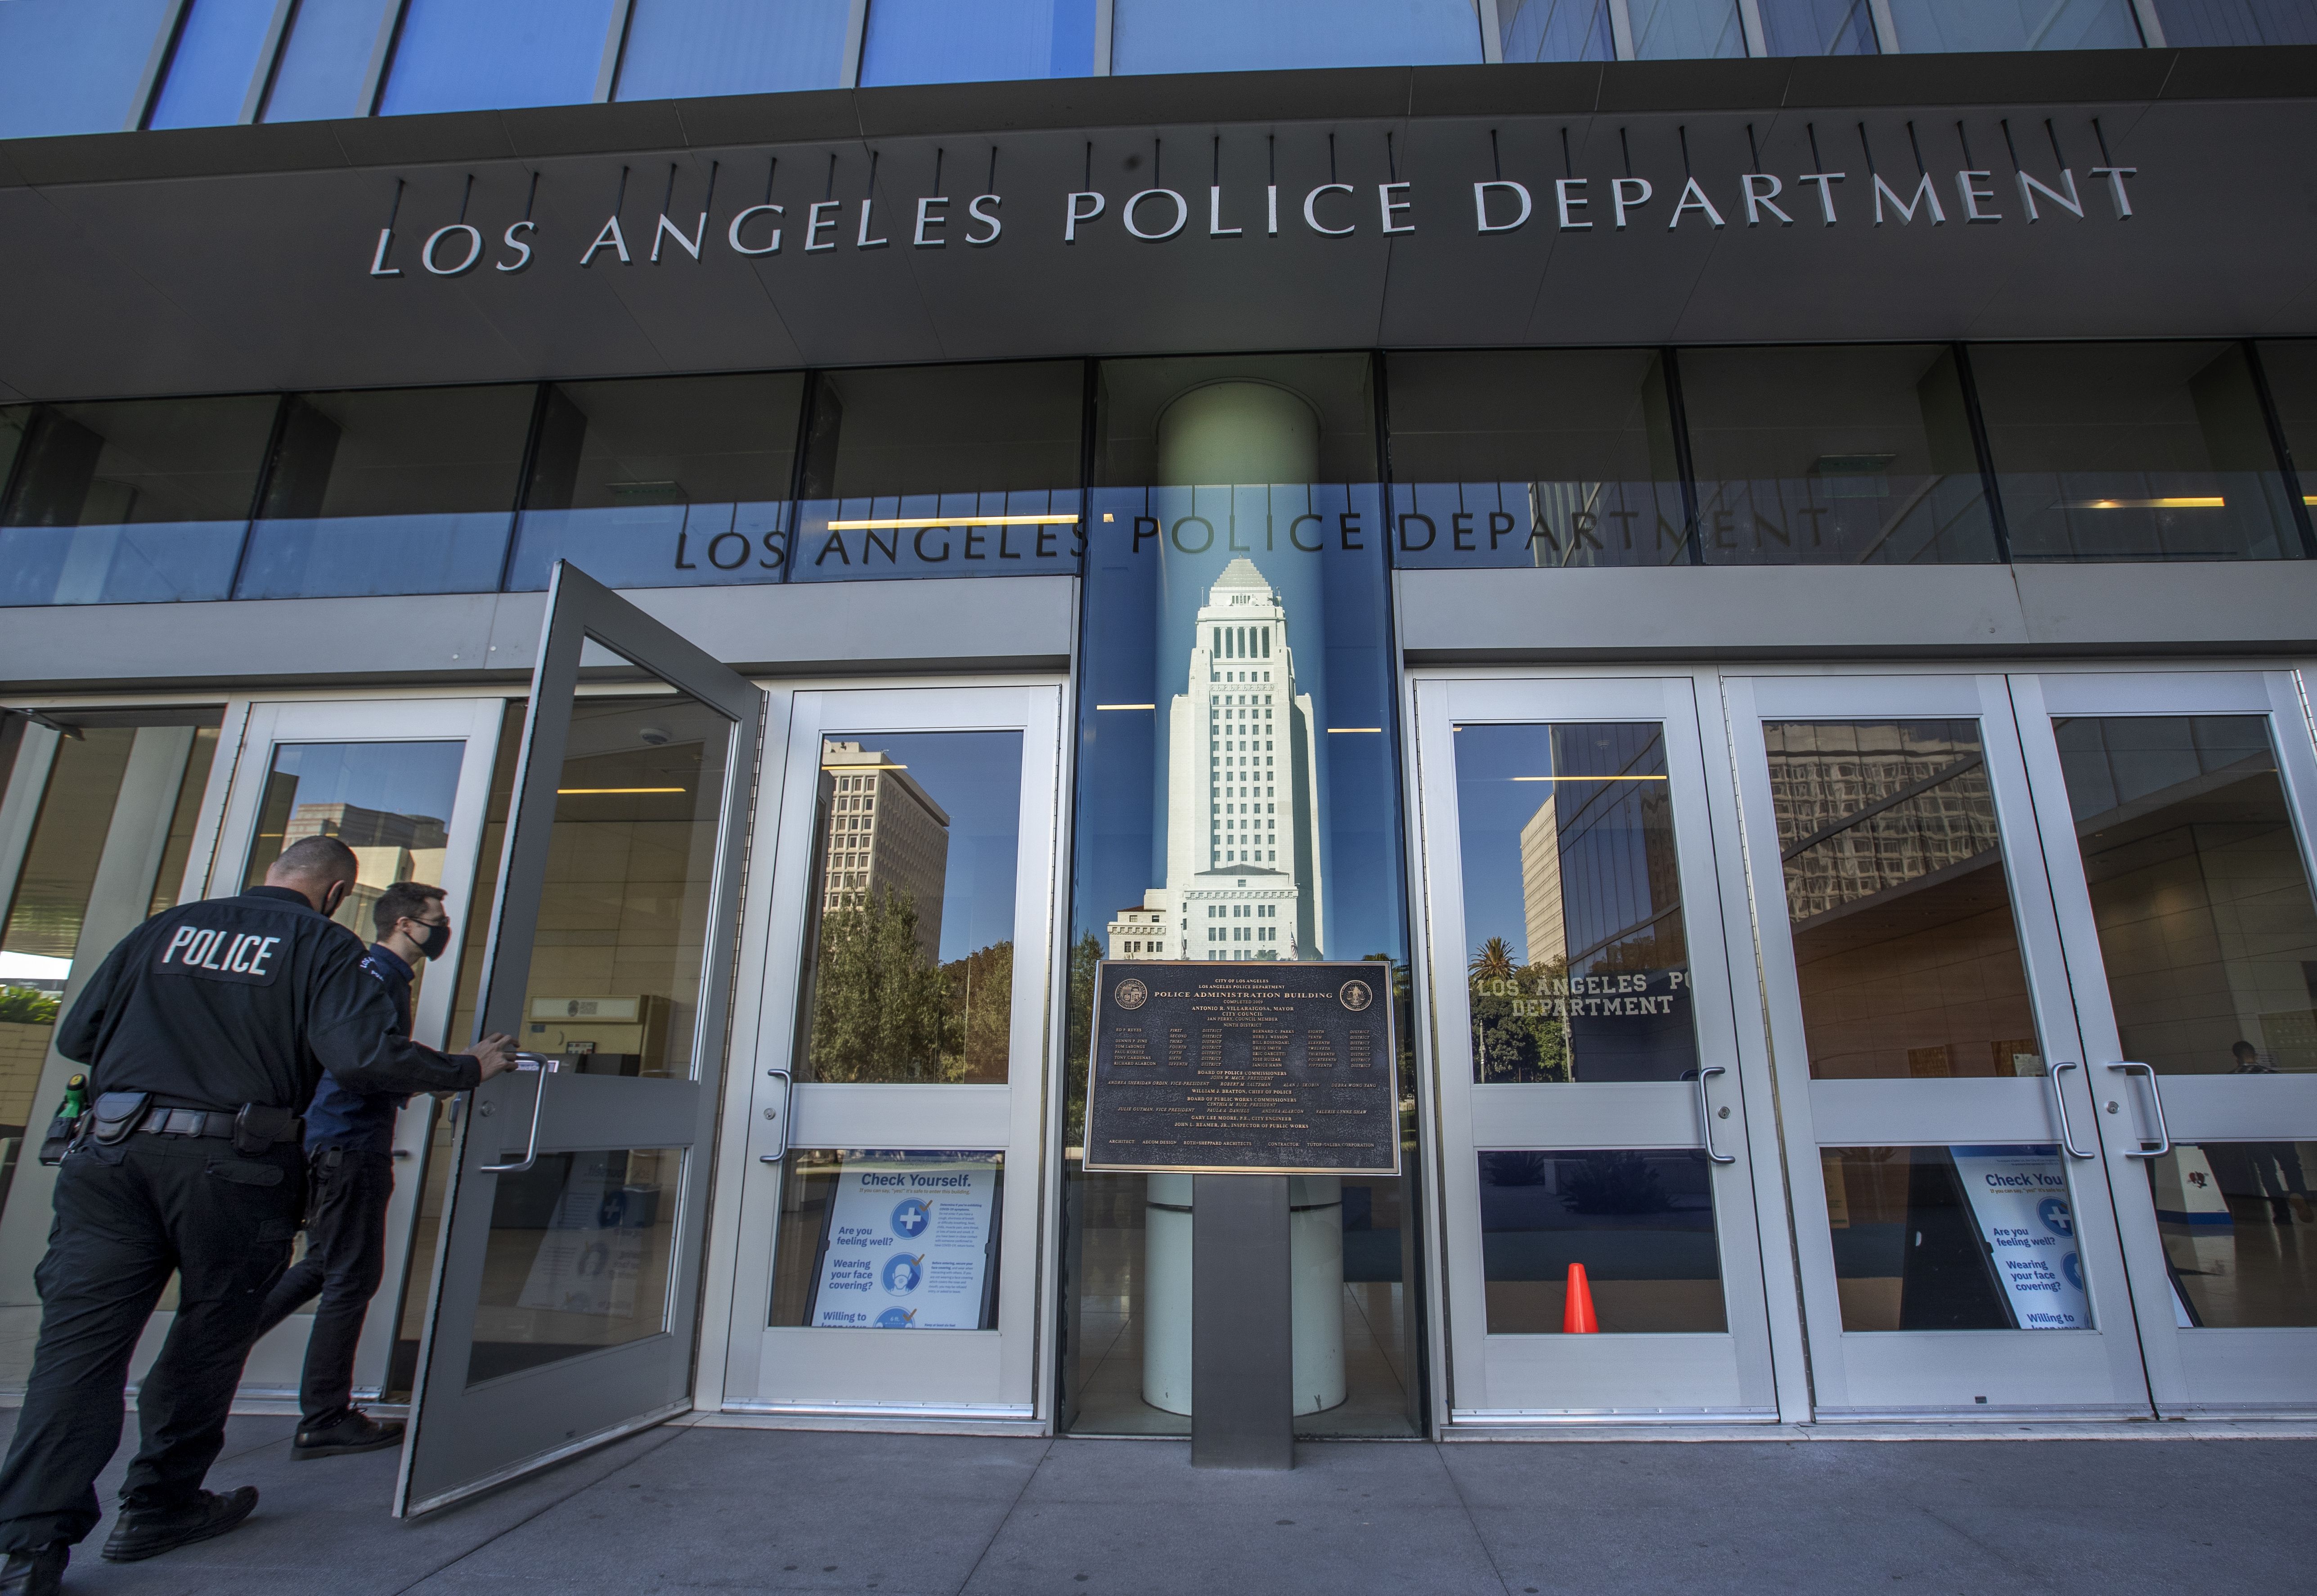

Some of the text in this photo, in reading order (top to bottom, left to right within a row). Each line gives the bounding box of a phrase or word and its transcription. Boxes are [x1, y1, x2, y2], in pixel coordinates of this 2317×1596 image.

[370, 167, 2137, 278] LOS ANGELES POLICE DEPARTMENT
[674, 508, 1828, 570] LOS ANGELES POLICE DEPARTMENT
[162, 926, 281, 976] POLICE
[1478, 979, 1519, 996] LOS
[1536, 974, 1647, 995] ANGELES
[1513, 995, 1673, 1017] DEPARTMENT
[862, 1173, 971, 1187] Check Yourself.
[1985, 1173, 2063, 1186] Check You
[839, 1227, 872, 1237] Are you
[2011, 1228, 2029, 1237] you
[837, 1237, 893, 1247] feeling well?
[1997, 1237, 2055, 1247] feeling well?
[834, 1260, 871, 1270] Wearing
[2006, 1260, 2048, 1270] Wearing
[831, 1270, 873, 1280] your face
[2011, 1271, 2055, 1282] your face
[829, 1281, 873, 1291] covering?
[2016, 1282, 2061, 1292] covering?
[823, 1312, 855, 1323] Willing
[2027, 1314, 2064, 1324] Willing
